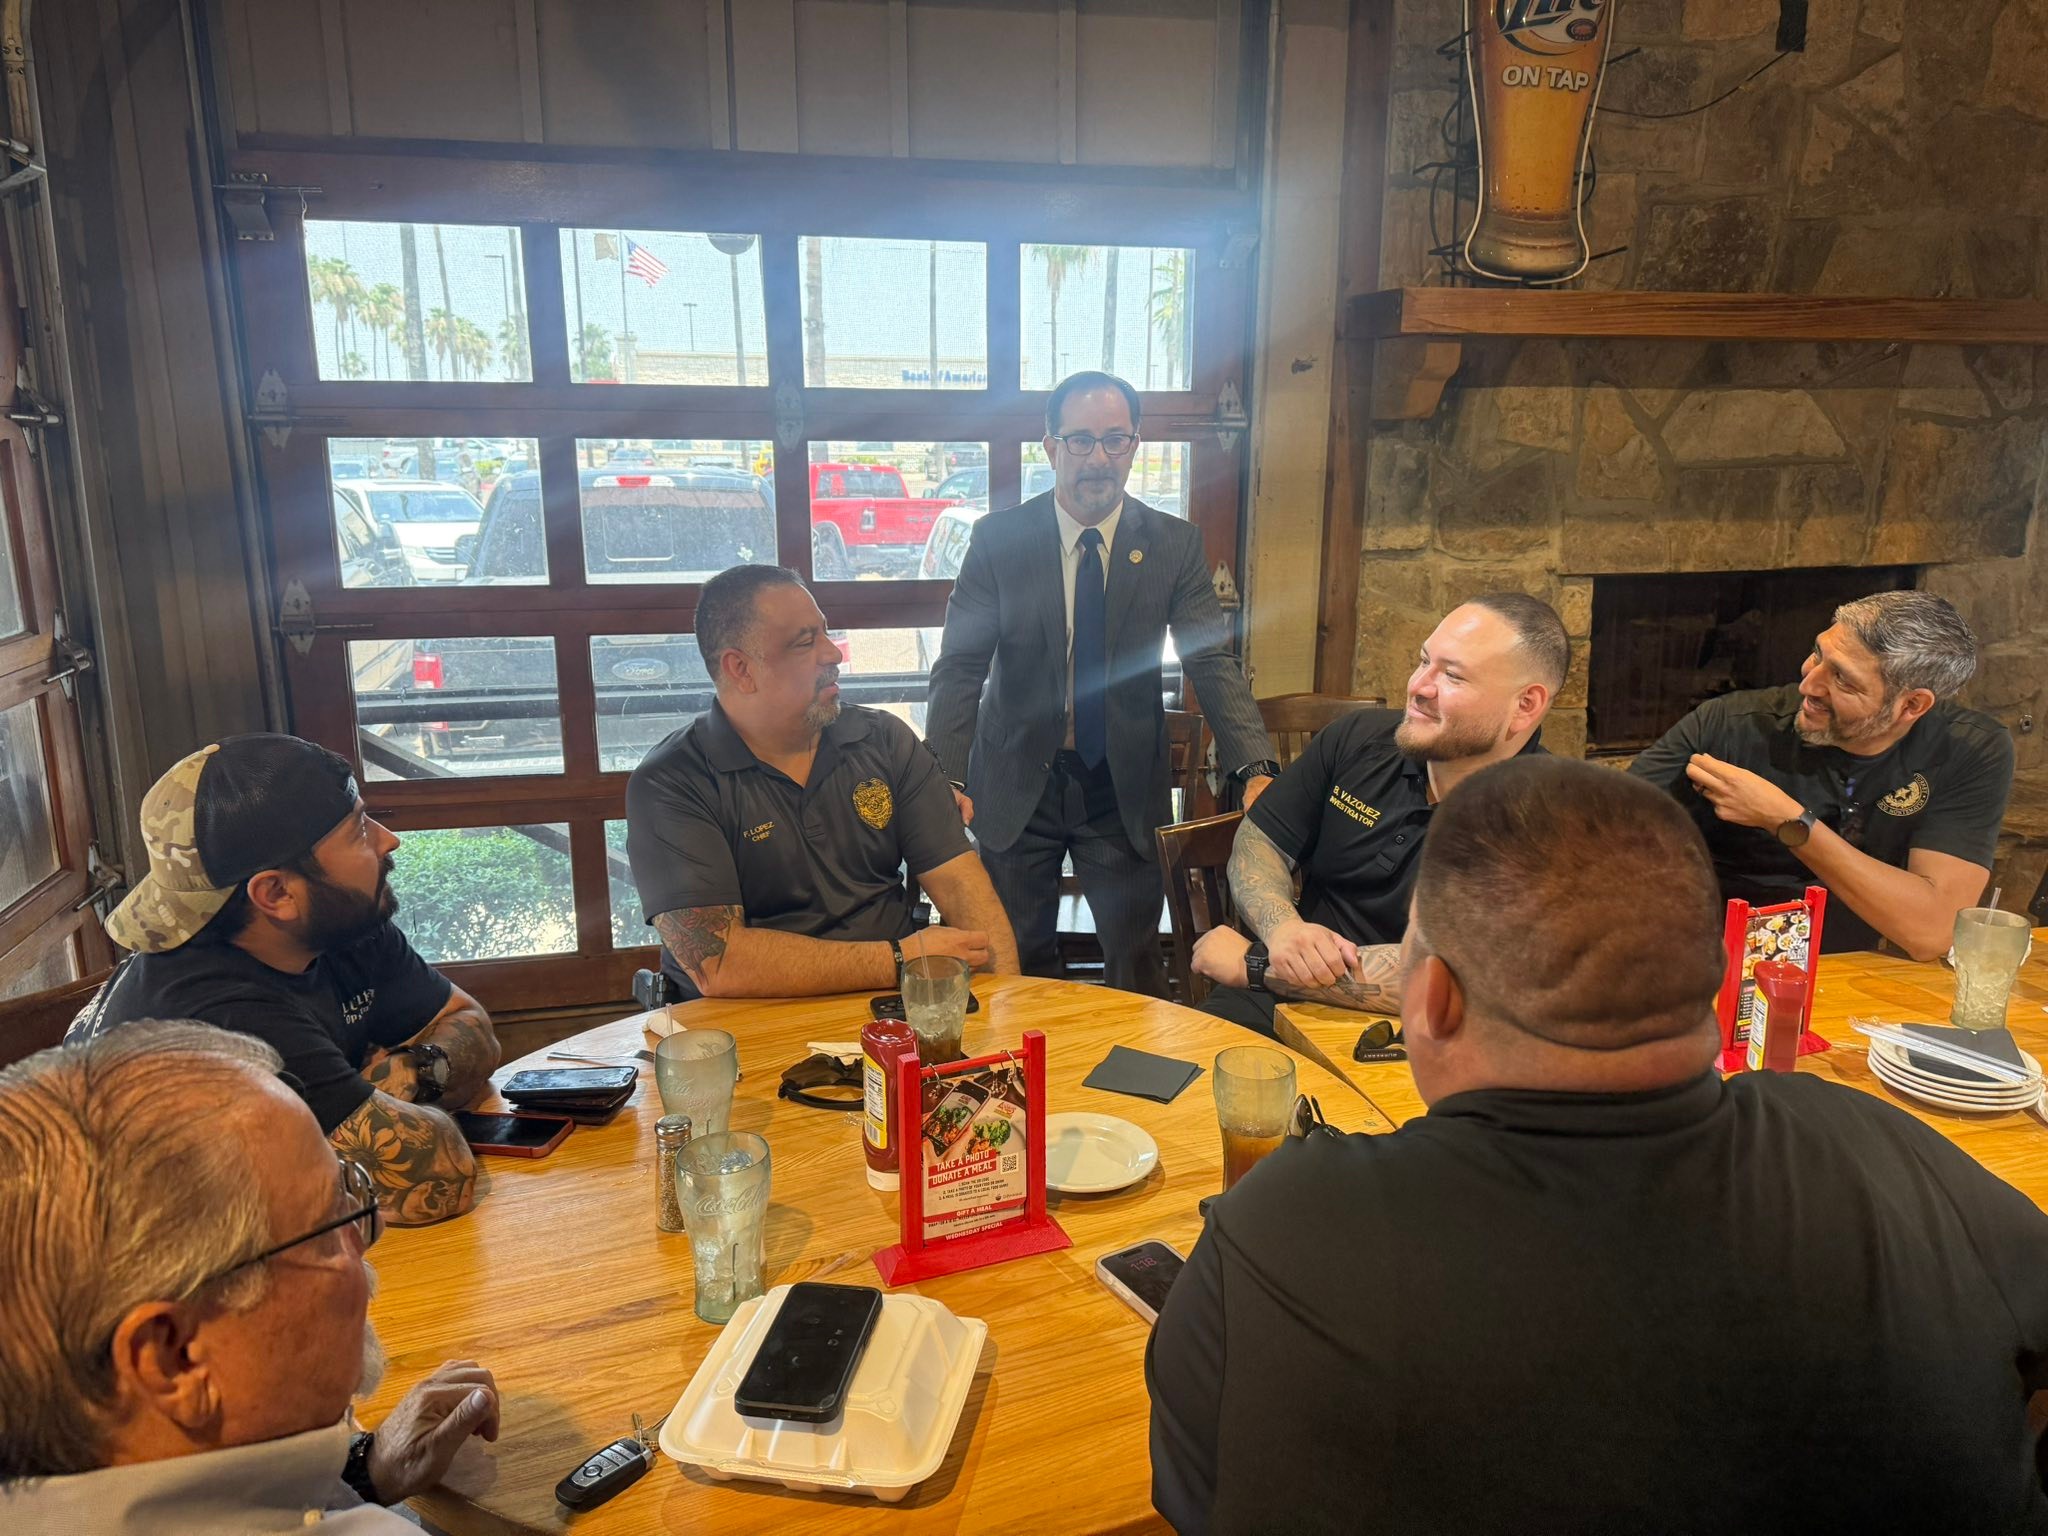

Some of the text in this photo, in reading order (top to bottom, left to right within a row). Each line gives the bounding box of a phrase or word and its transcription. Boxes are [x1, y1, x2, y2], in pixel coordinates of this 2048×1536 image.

[1502, 66, 1589, 91] ON TAP
[1329, 795, 1375, 828] INVESTIGATOR
[1340, 790, 1381, 820] VAZQUEZ
[936, 1150, 990, 1172] TAKE A PHOTO
[932, 1162, 993, 1185] DONATE A MEAL
[945, 1221, 1003, 1241] WEDNESDAY SPECIAL
[1130, 1257, 1157, 1271] 1:18
